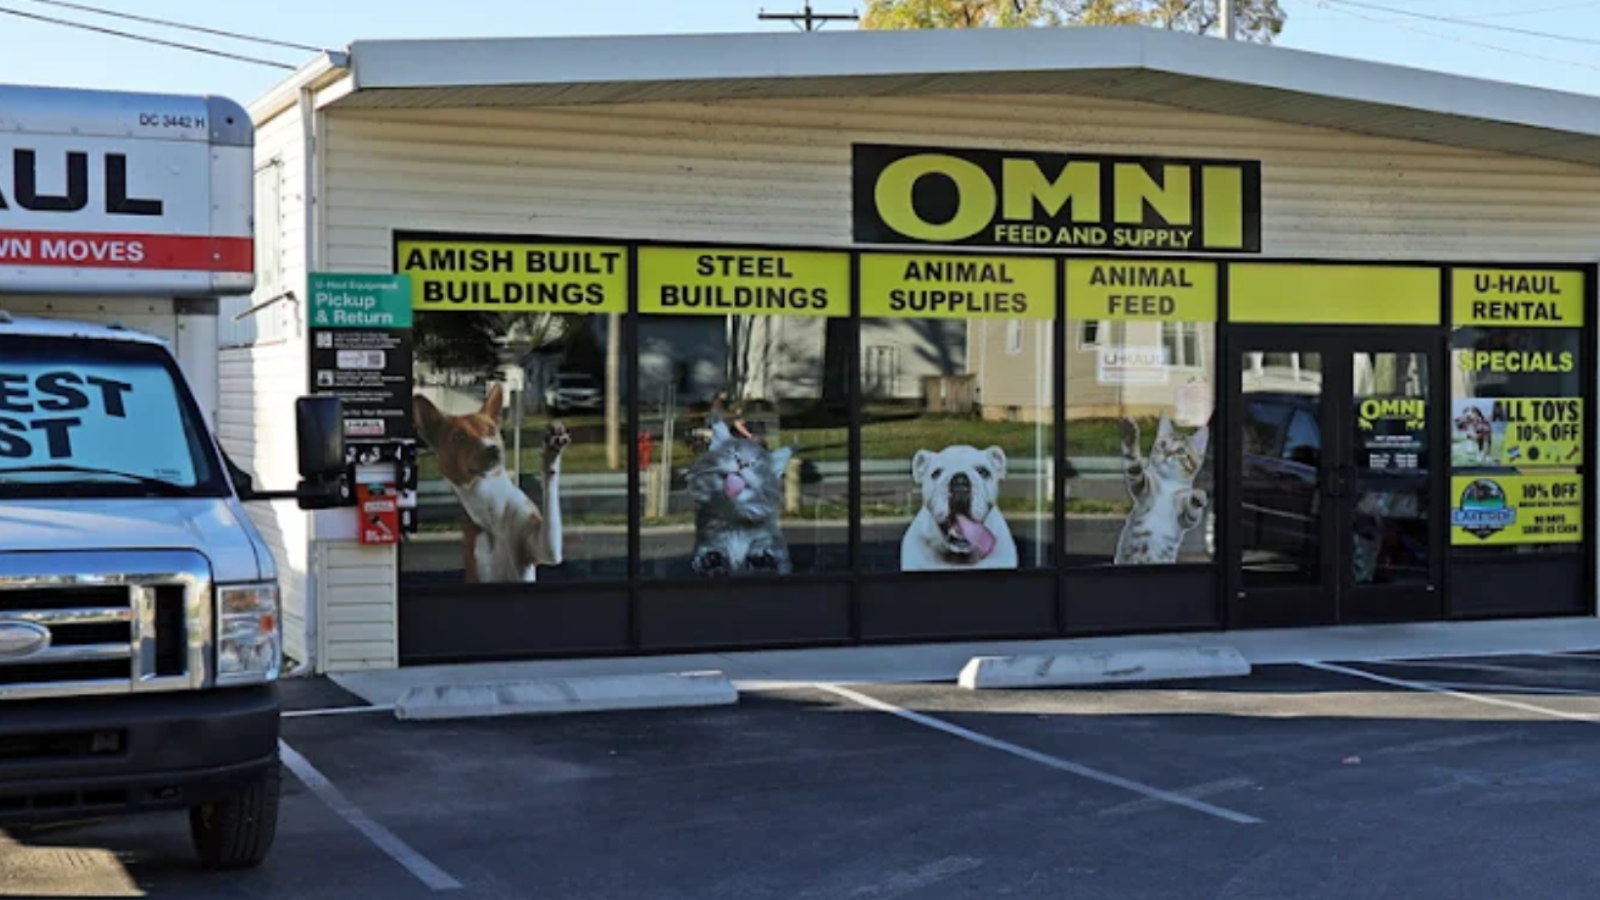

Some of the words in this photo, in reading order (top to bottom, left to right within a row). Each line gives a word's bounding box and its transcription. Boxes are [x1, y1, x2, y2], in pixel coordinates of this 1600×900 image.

[139, 113, 160, 127] DC
[163, 114, 192, 128] 3442
[195, 115, 205, 129] H
[0, 148, 164, 216] UL
[874, 153, 1243, 249] OMNI
[994, 225, 1051, 244] FEED
[1056, 227, 1107, 246] AND
[1113, 229, 1193, 249] SUPPLY
[40, 239, 145, 262] MOVES
[405, 247, 514, 273] AMISH
[526, 251, 621, 275] BUILT
[696, 254, 793, 279] STEEL
[903, 260, 1014, 284] ANIMAL
[1089, 265, 1193, 288] ANIMAL
[423, 280, 605, 305] BUILDINGS
[1474, 273, 1562, 295] U-HAUL
[315, 292, 376, 310] Pickup
[660, 284, 828, 310] BUILDINGS
[889, 289, 1029, 314] SUPPLIES
[1107, 294, 1175, 317] FEED
[315, 309, 328, 324] &
[333, 310, 393, 324] Return
[1472, 301, 1563, 321] RENTAL
[1459, 350, 1574, 373] SPECIALS
[1360, 399, 1425, 420] OMNI
[1492, 400, 1527, 422] ALL
[1530, 401, 1579, 422] TOYS
[1516, 425, 1548, 441] 10%
[1550, 423, 1579, 441] OFF
[1522, 484, 1548, 499] 10%
[1552, 483, 1577, 498] OFF
